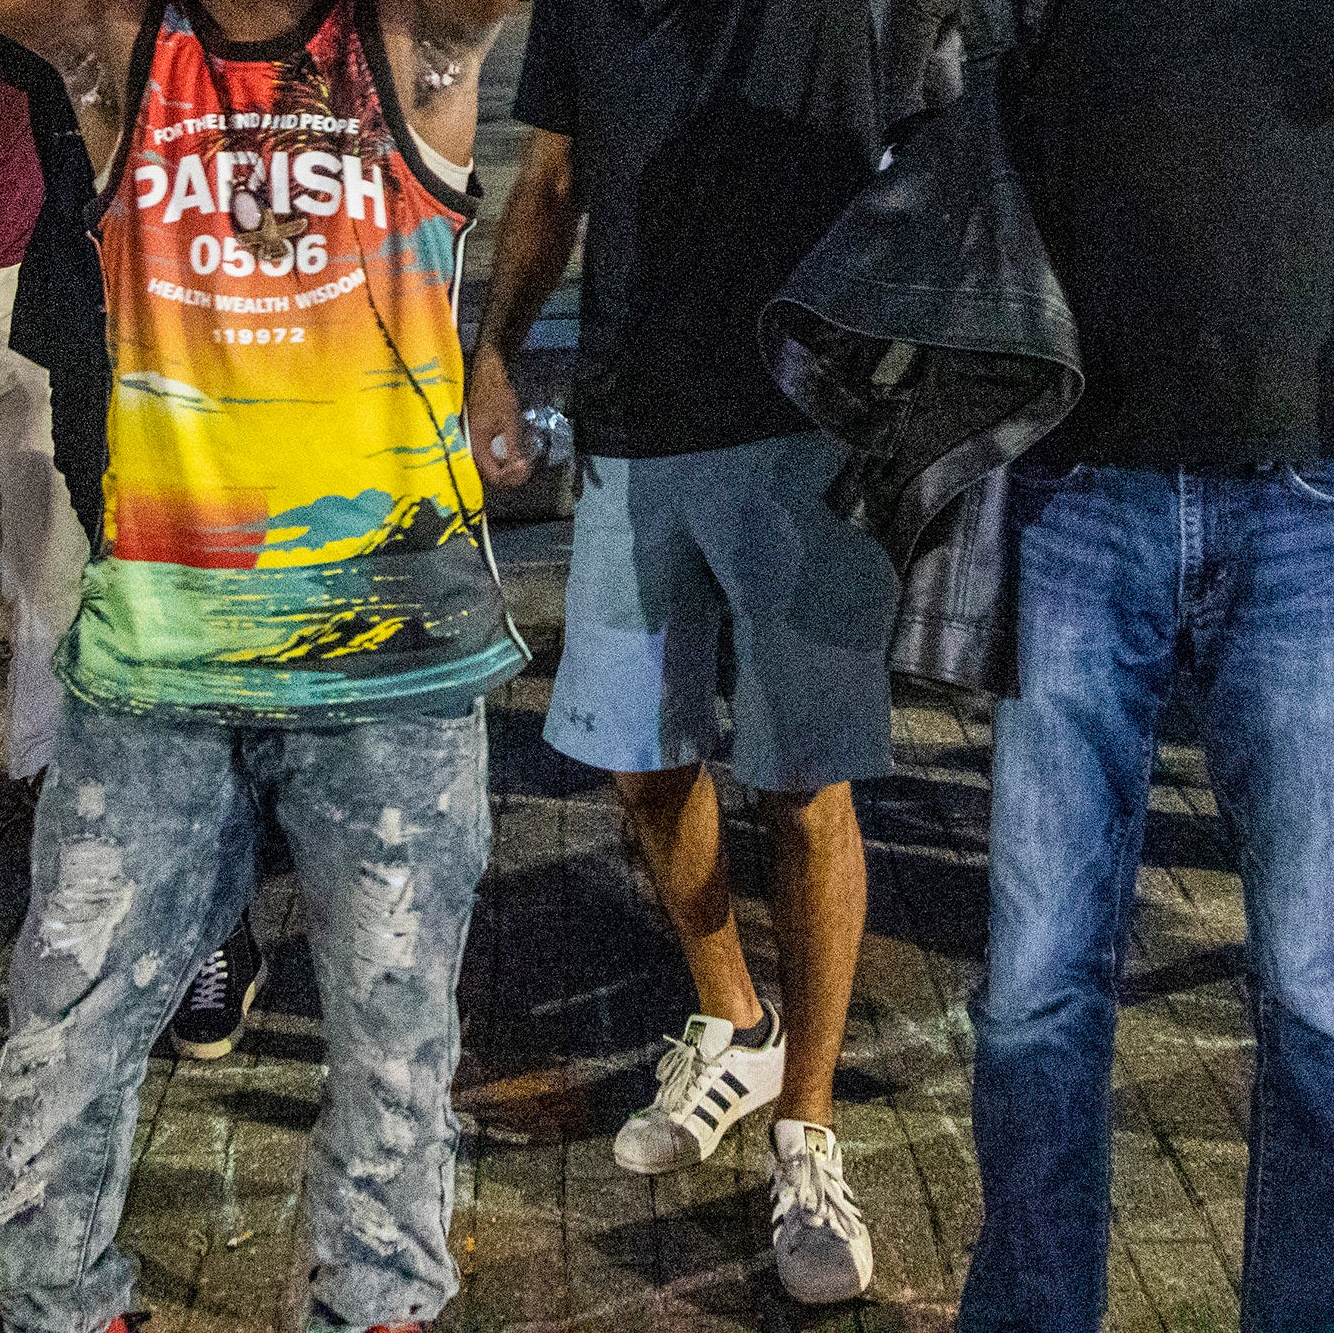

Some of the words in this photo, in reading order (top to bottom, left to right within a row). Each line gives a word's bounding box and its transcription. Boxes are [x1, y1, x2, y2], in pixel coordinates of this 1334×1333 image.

[146, 277, 212, 308] HEALTH
[214, 294, 290, 314] WEALTH
[294, 267, 367, 310] WISDOM
